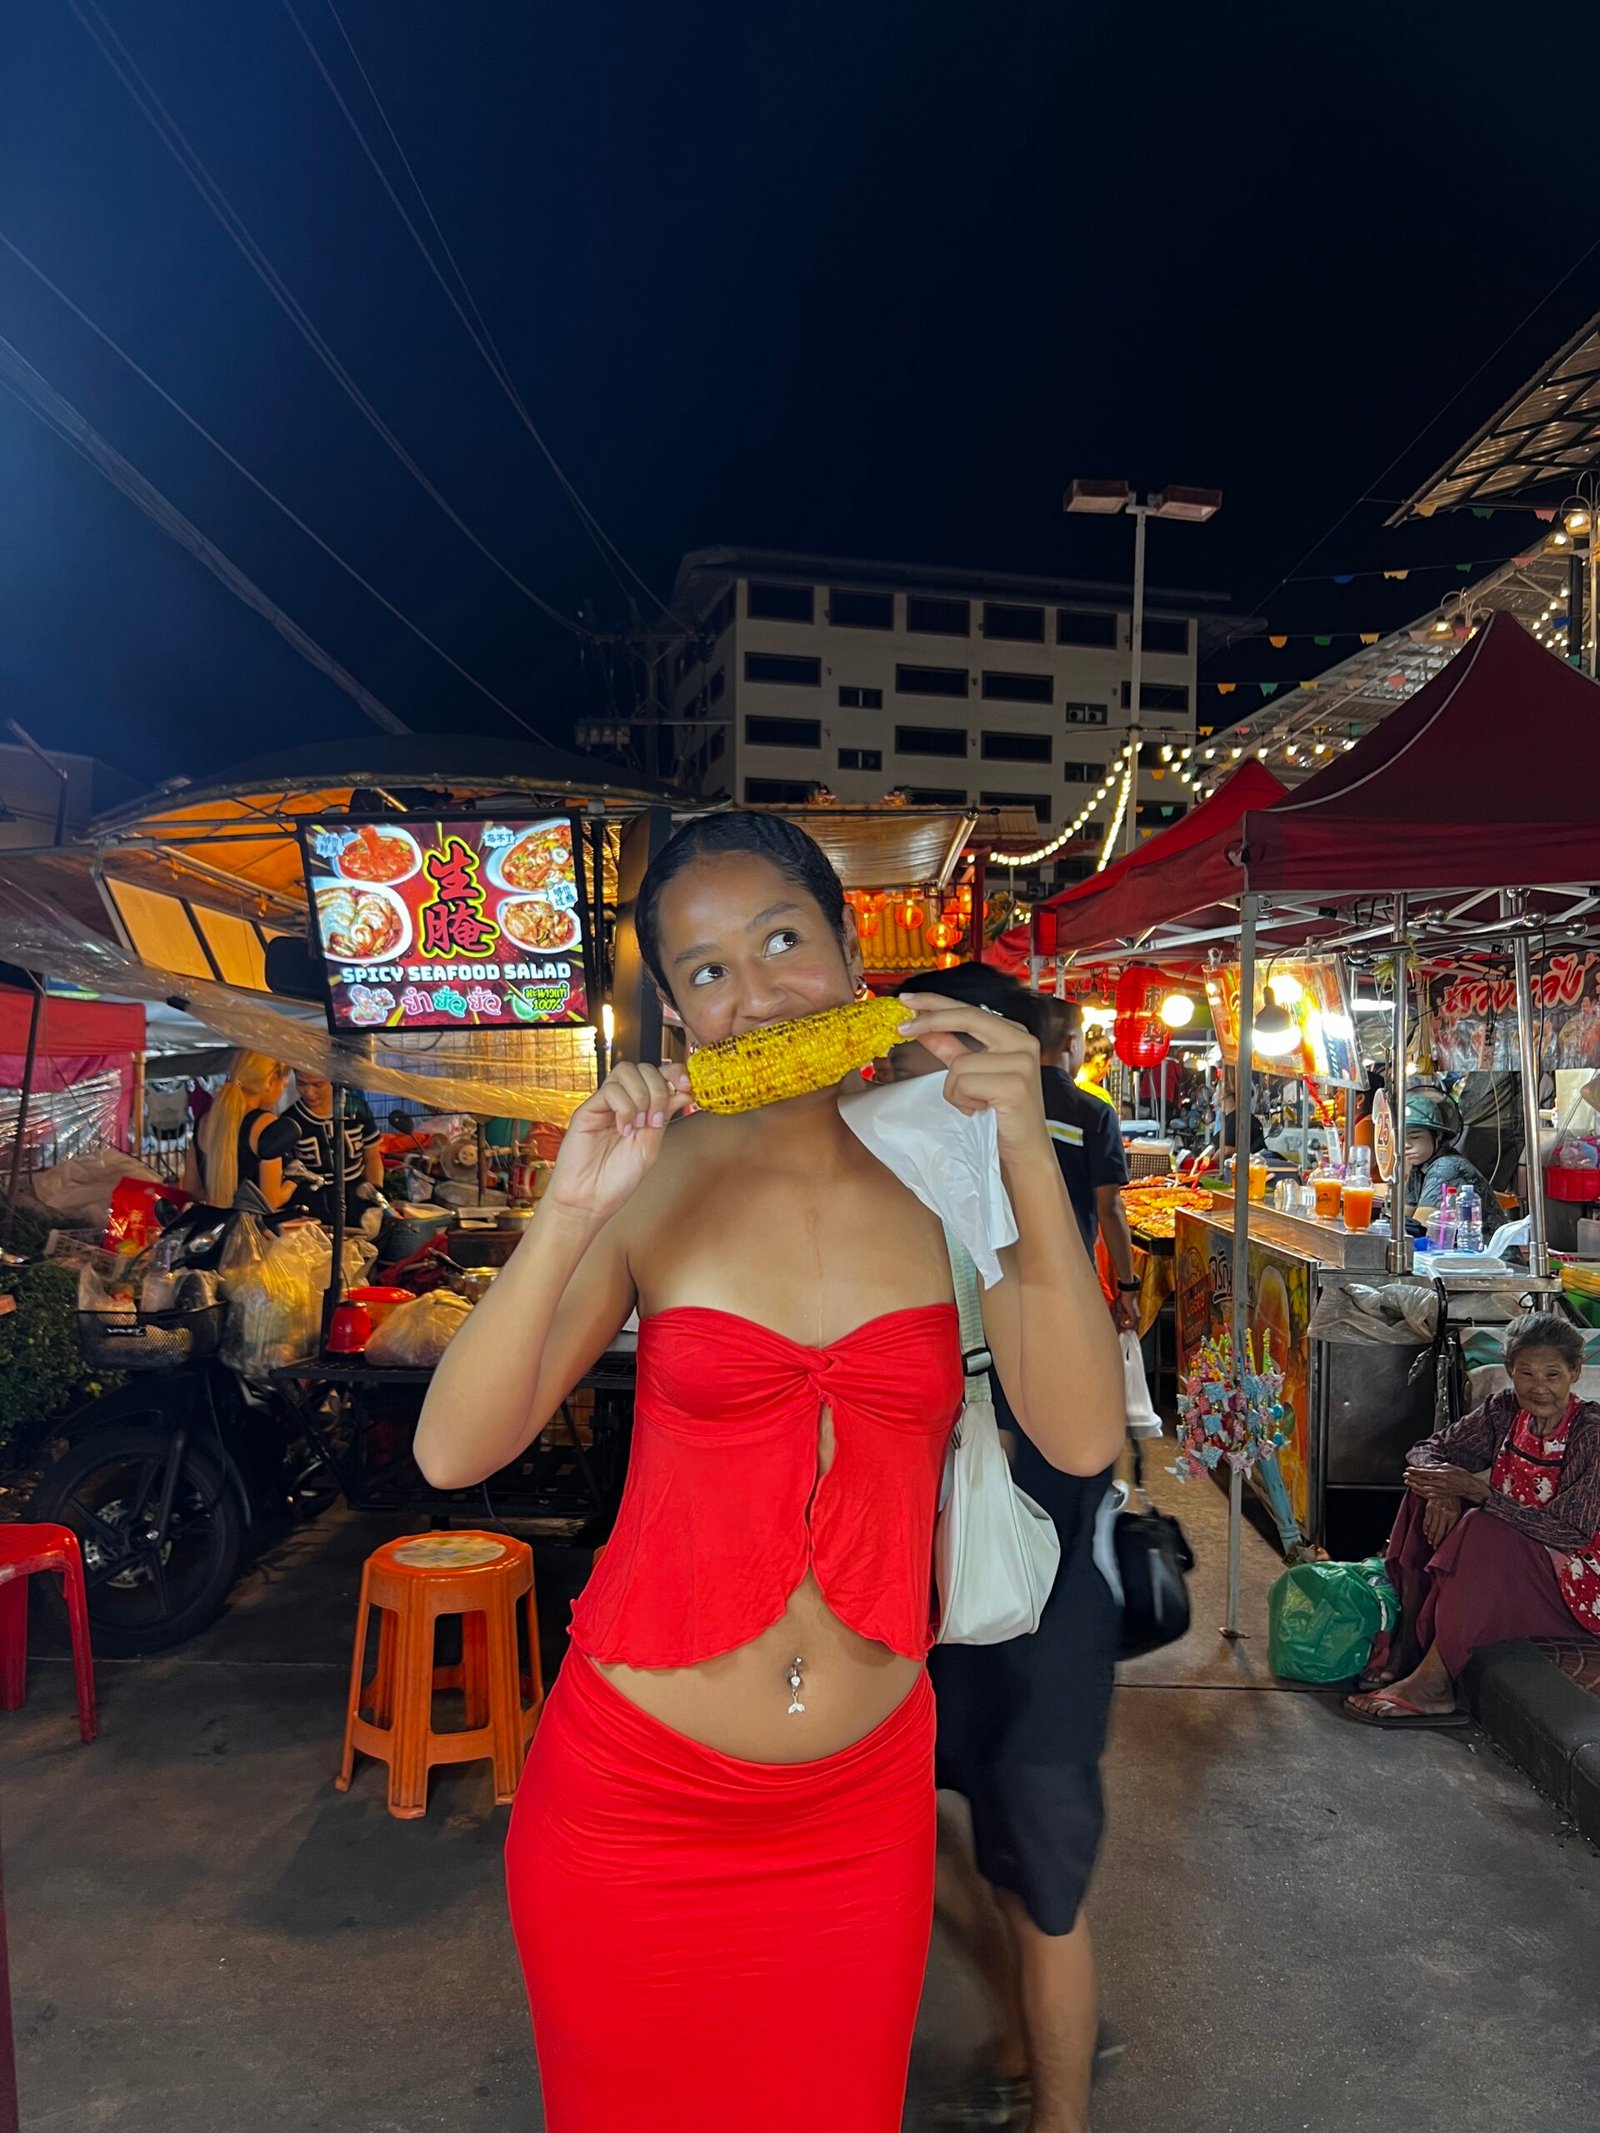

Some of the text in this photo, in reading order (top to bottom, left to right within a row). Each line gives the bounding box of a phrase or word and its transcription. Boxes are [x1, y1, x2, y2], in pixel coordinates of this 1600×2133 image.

[342, 963, 571, 983] SPICY SEAFOOD SALAD
[533, 998, 562, 1011] 100%
